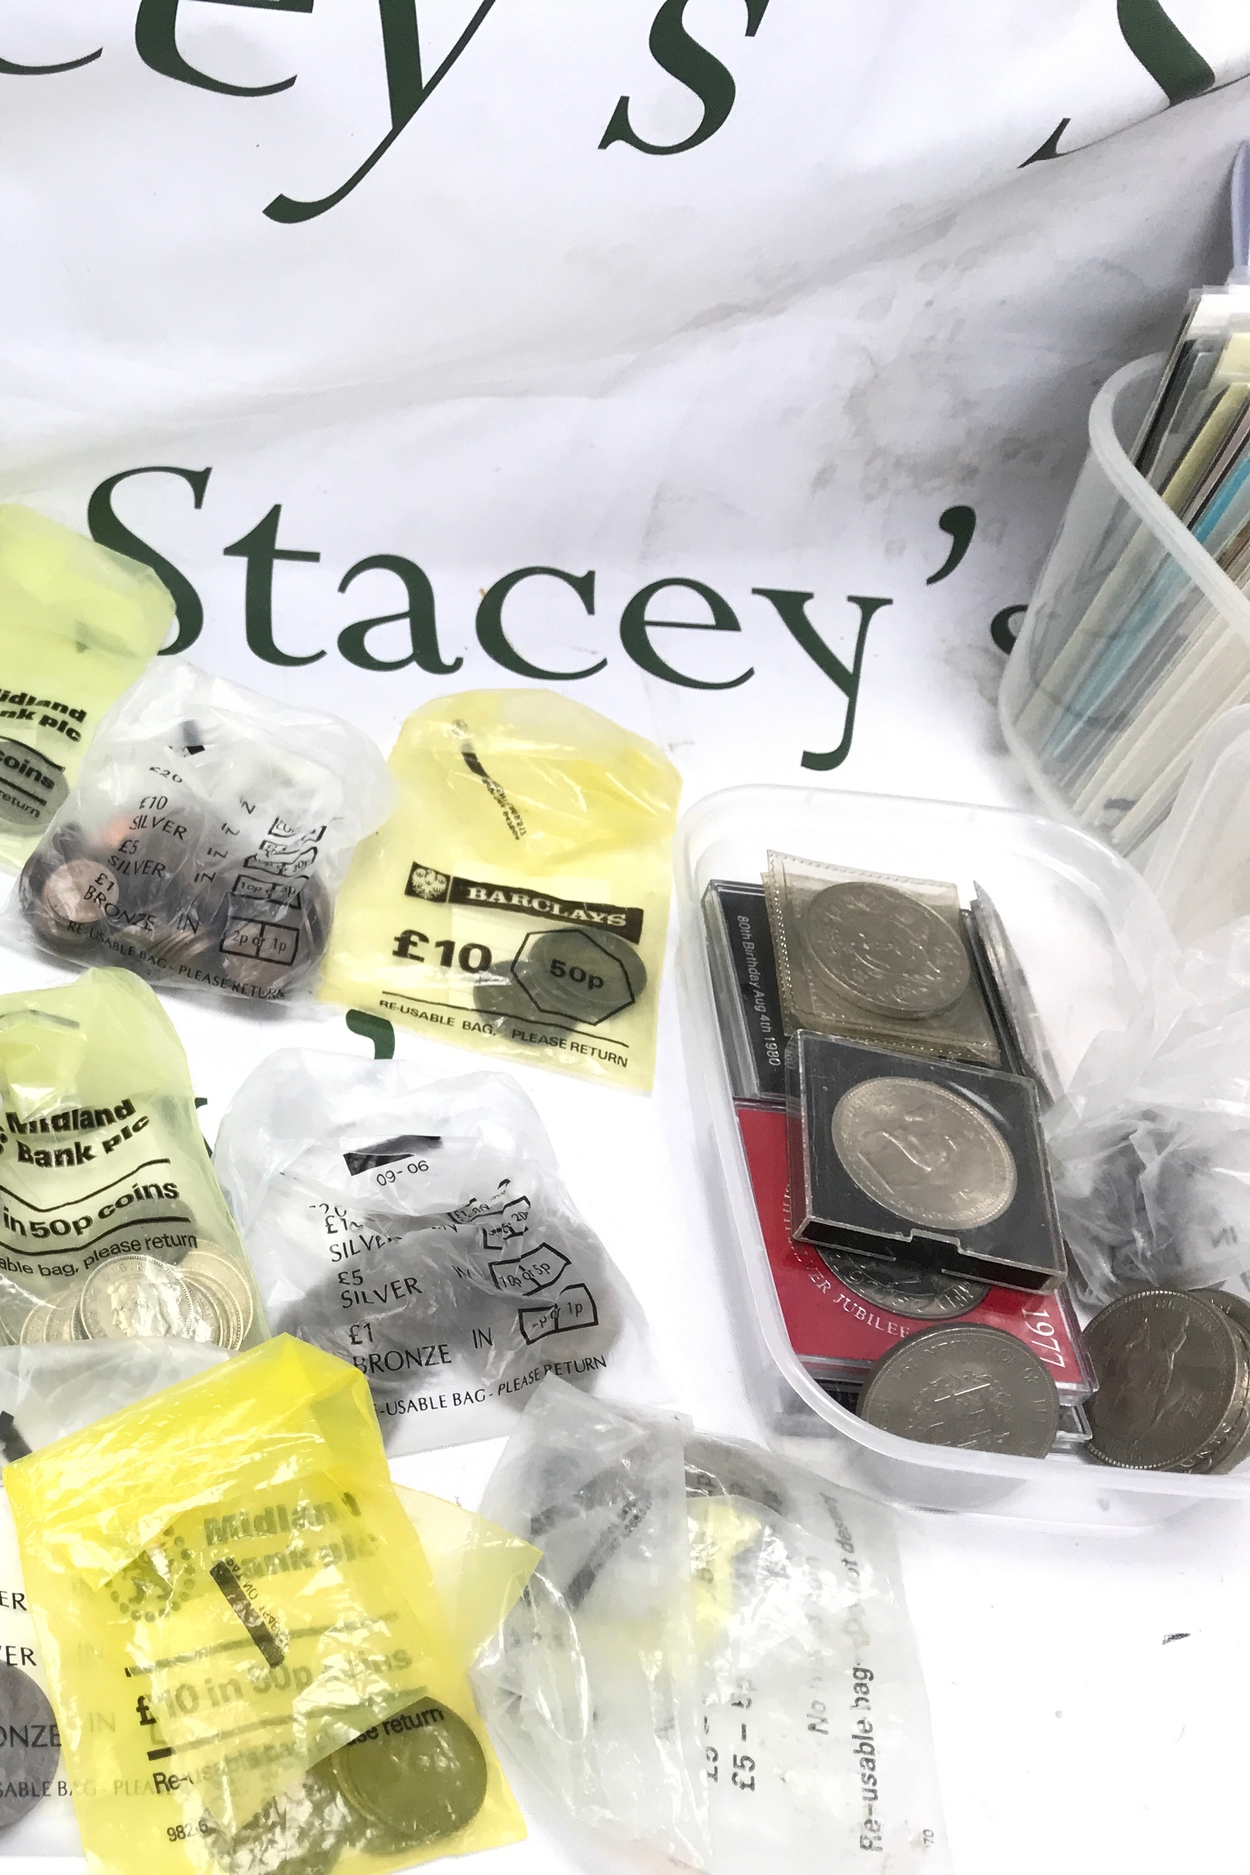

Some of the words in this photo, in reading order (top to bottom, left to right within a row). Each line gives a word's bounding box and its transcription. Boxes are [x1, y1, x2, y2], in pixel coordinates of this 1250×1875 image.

[38, 711, 83, 743] plc
[139, 796, 169, 811] £10
[129, 814, 188, 841] SILVER
[118, 839, 138, 855] £5
[94, 872, 115, 892] £1
[194, 871, 217, 885] IN
[107, 855, 167, 878] SILVER
[207, 847, 228, 859] IN
[240, 881, 263, 894] 10p
[83, 886, 157, 933] BRONZE
[176, 912, 201, 934] IN
[232, 930, 249, 947] 2p
[252, 936, 266, 946] or
[273, 936, 288, 953] 1p
[467, 886, 627, 928] BARCLAYS
[737, 914, 751, 941] 80th
[391, 929, 493, 975] £10
[741, 940, 762, 988] Birthday
[179, 965, 228, 989] PLEASE
[231, 982, 286, 999] RETURN
[550, 958, 605, 991] 50p
[753, 986, 767, 1014] Aug
[379, 999, 455, 1027] RE-USABLE
[512, 1030, 567, 1049] PLEASE
[570, 1041, 628, 1068] RETURN
[758, 1014, 771, 1042] 4th
[764, 1040, 782, 1067] 1980
[5, 1099, 137, 1134] Midland
[16, 1139, 97, 1168] Bank
[102, 1115, 150, 1155] plc
[3, 1214, 26, 1237] in
[30, 1215, 93, 1240] 50p
[98, 1181, 180, 1220] coins
[38, 1261, 80, 1278] bag,
[83, 1239, 142, 1272] please
[145, 1232, 199, 1252] return
[330, 1235, 402, 1263] SILVE
[337, 1270, 364, 1286] £5
[340, 1277, 423, 1309] SILVER
[533, 1260, 552, 1279] 5p
[833, 1293, 911, 1339] JUBILEE
[349, 1323, 374, 1346] £1
[354, 1344, 453, 1376] BRONZE
[472, 1328, 493, 1350] IN
[566, 1301, 583, 1318] 1p
[1021, 1306, 1068, 1369] 1977
[497, 1368, 541, 1396] PLEASE
[208, 1677, 245, 1707] in
[383, 1706, 445, 1734] return
[732, 1755, 756, 1791] £5
[852, 1713, 883, 1852] Re-usable
